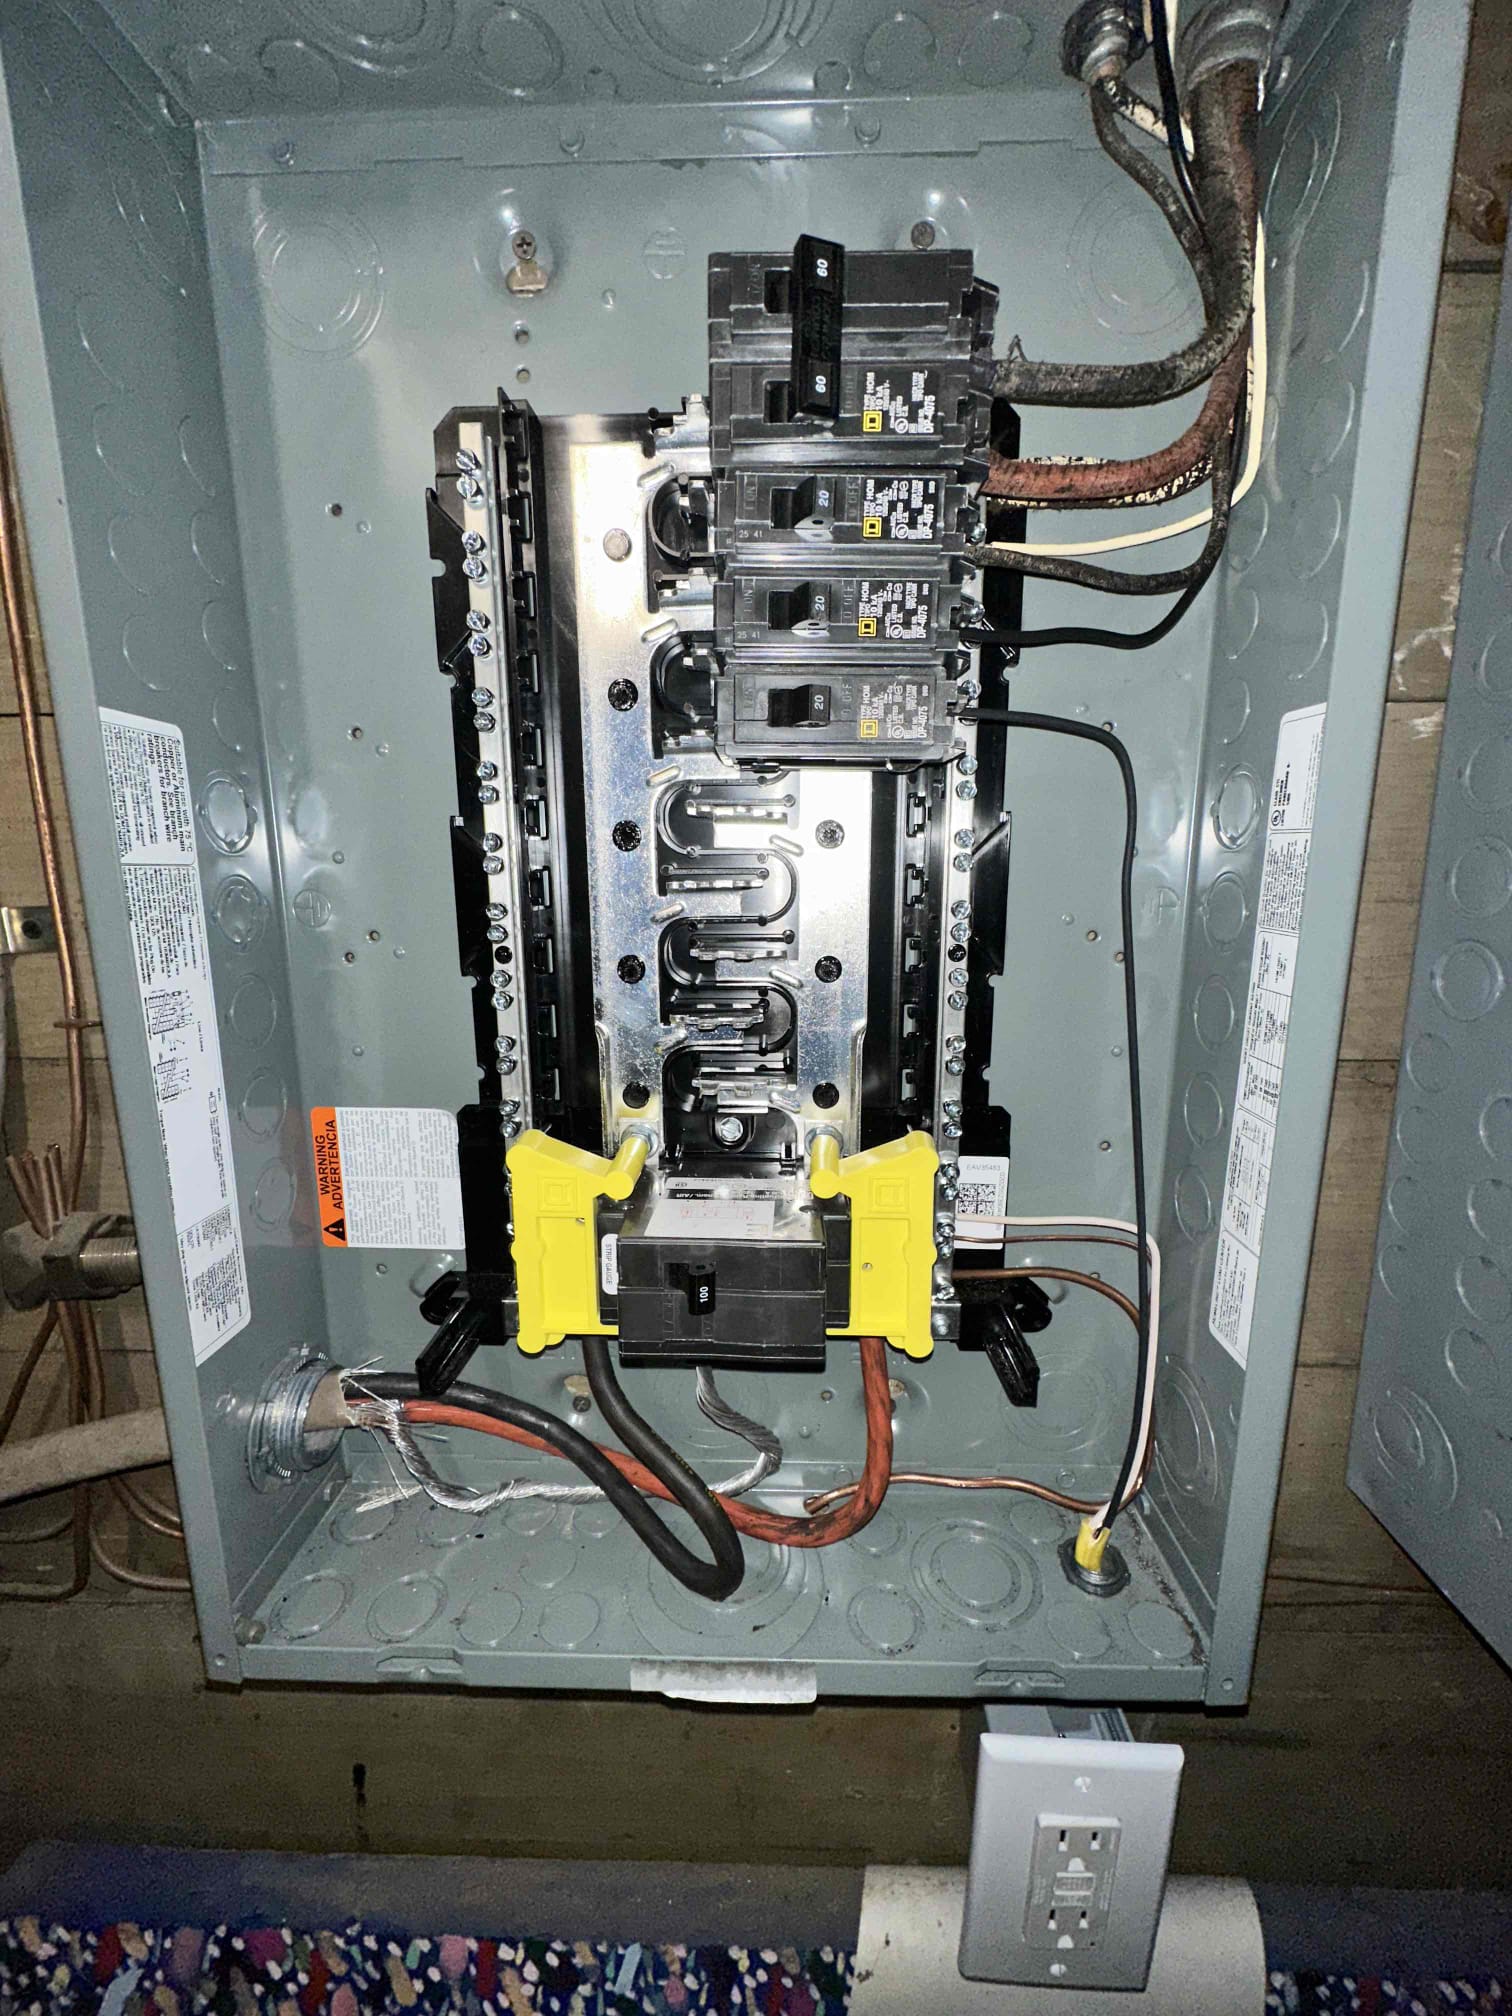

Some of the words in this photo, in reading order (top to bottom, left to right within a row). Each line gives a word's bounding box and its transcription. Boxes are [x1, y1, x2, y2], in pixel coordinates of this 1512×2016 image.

[816, 259, 828, 277] 60
[815, 375, 826, 393] 60
[866, 372, 875, 393] HOM
[923, 395, 935, 433] DP-4075
[819, 490, 829, 506] 20
[866, 479, 874, 499] HOM
[923, 504, 934, 539] DP-4075
[861, 582, 869, 601] HOM
[815, 596, 825, 611] 20
[917, 605, 928, 638] DP-4075
[814, 695, 824, 710] 20
[918, 706, 928, 738] DP-4075
[160, 737, 171, 788] conductors.
[167, 738, 176, 769] Copper
[174, 739, 183, 774] Suitable
[154, 735, 164, 773] breakers
[160, 791, 170, 821] branch
[172, 772, 178, 782] or
[177, 777, 185, 789] for
[167, 792, 175, 808] See
[173, 784, 183, 828] Aluminum
[170, 811, 178, 840] branch
[182, 810, 190, 826] with
[185, 830, 191, 839] 75
[315, 1135, 329, 1195] WARNING
[325, 1120, 343, 1209] ADVERTENCIA
[699, 1286, 709, 1303] 100
